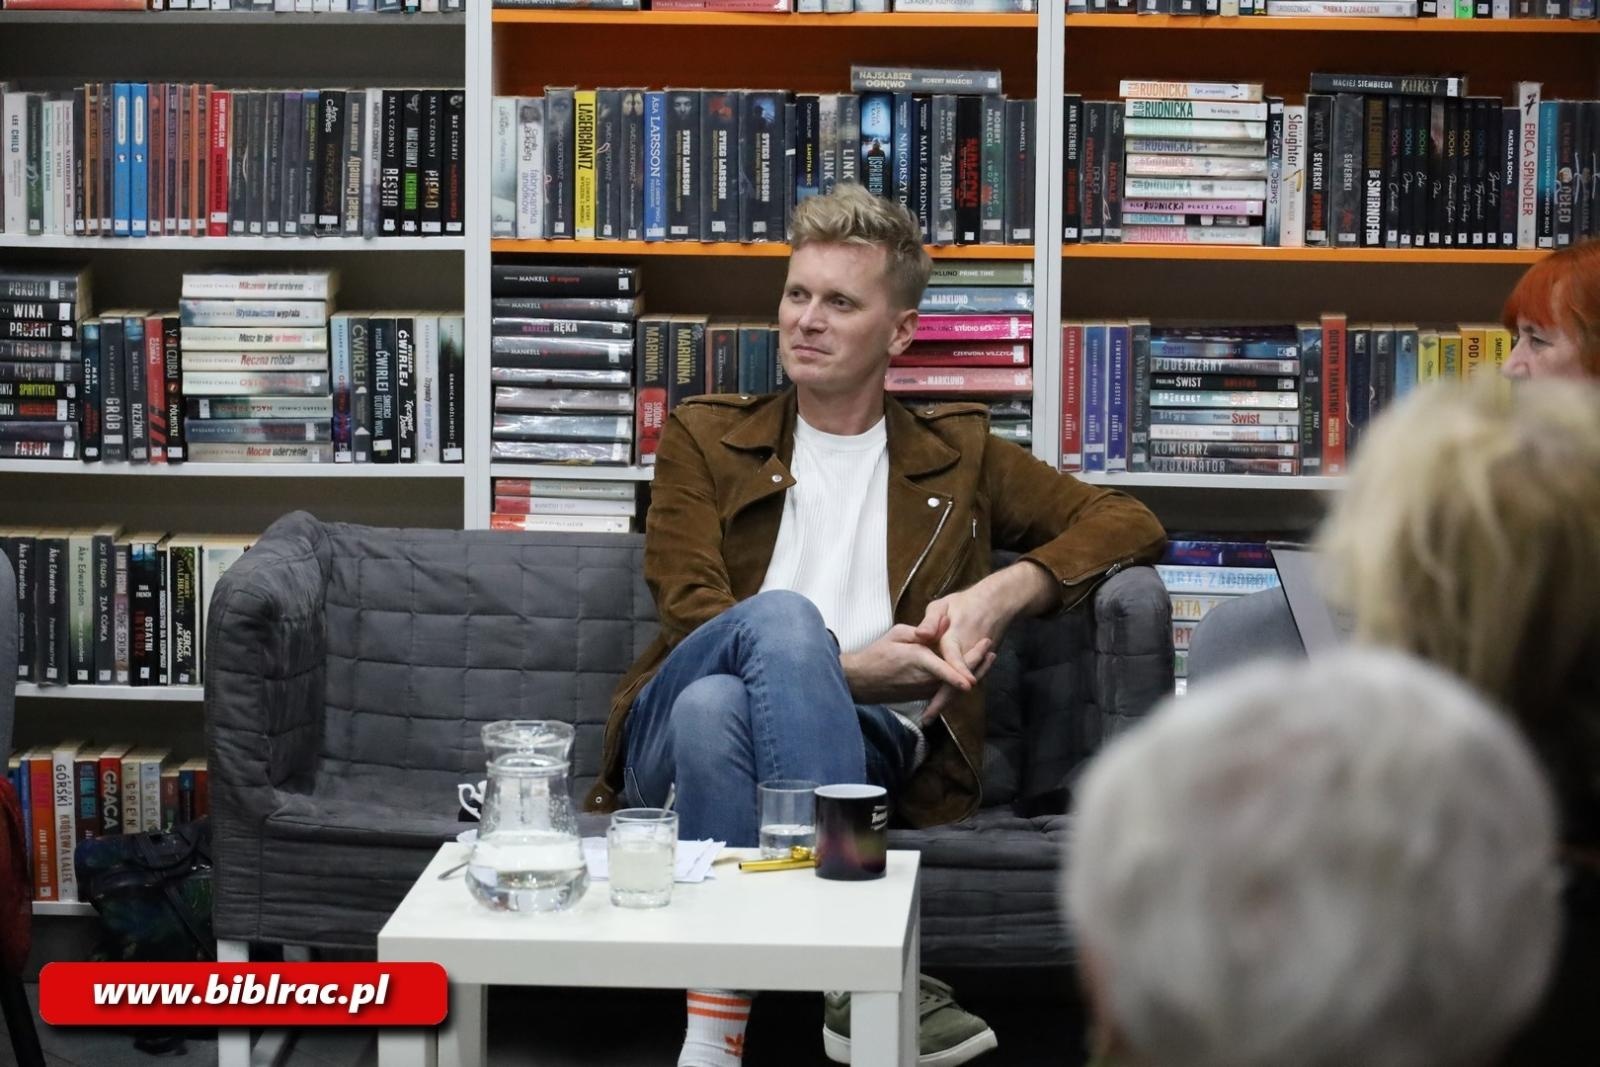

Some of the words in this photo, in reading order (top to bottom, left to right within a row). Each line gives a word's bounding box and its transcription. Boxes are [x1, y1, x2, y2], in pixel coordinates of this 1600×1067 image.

[859, 71, 913, 80] NAJSŁABSZE
[865, 79, 907, 90] OGNIWO
[921, 77, 944, 85] ROBERT
[1332, 79, 1356, 87] MACIEJ
[1357, 80, 1393, 89] SIEMBIEDA
[1400, 79, 1439, 93] KUKŁY
[1139, 83, 1188, 98] RUDNICKA
[324, 99, 333, 133] Cleeves
[330, 106, 338, 122] Ann
[651, 96, 660, 114] ÅSA
[1145, 100, 1193, 118] RUDNICKA
[11, 115, 20, 126] LEE
[406, 127, 418, 141] MAX
[1314, 111, 1322, 142] VINCENT
[10, 129, 19, 153] CHILD
[386, 118, 394, 158] CZORNYJ
[427, 118, 435, 158] CZORNYJ
[578, 103, 593, 170] LAGERCRANTZ
[650, 116, 660, 177] LARSSON
[682, 130, 690, 155] STIEG
[718, 130, 726, 157] STIEG
[761, 133, 769, 159] STIEG
[919, 135, 927, 165] MAŁE
[1067, 124, 1076, 160] ROZENBERG
[1145, 141, 1193, 152] RUDNICKA
[1270, 119, 1280, 159] TATRACH
[1285, 113, 1302, 167] Slaughter
[1524, 122, 1535, 157] ERICA
[406, 142, 417, 168] CZORNYJ
[823, 150, 834, 180] LINK
[842, 149, 854, 179] LINK
[896, 132, 907, 193] NAJGORSZY
[1271, 161, 1280, 170] W
[346, 156, 361, 195] Connelly
[682, 157, 690, 196] LARSSON
[718, 158, 726, 199] LARSSON
[761, 161, 769, 202] LARSSON
[939, 154, 952, 211] ŻAŁOBNICA
[1313, 152, 1322, 190] SEVERSKI
[1343, 153, 1352, 191] SEVERSKI
[382, 168, 398, 207] BESTIA
[424, 170, 438, 209] PIEKŁO
[521, 172, 529, 215] aniołków
[526, 169, 539, 224] fabrykantka
[919, 166, 927, 221] ZBRODNIE
[1523, 160, 1534, 216] SPINDLER
[1143, 200, 1184, 211] RUDNICKA
[1558, 186, 1571, 223] OBŁĘD
[1140, 227, 1188, 242] RUDNICKA
[8, 282, 45, 297] POKUTA
[238, 281, 266, 290] Milczenie
[267, 282, 279, 291] jest
[279, 282, 304, 291] srebrem
[931, 294, 968, 305] MARKLUND
[13, 304, 44, 318] WINA
[276, 309, 300, 319] wypłata
[9, 322, 53, 338] PACJENT
[238, 333, 256, 343] Masz
[256, 333, 263, 342] to
[263, 334, 273, 344] jak
[553, 322, 578, 335] RĘKA
[954, 324, 979, 332] STUDIO
[11, 344, 53, 358] TRAUMA
[240, 354, 269, 366] Ręczna
[270, 354, 295, 365] robota
[352, 324, 368, 385] ĆWIRLEJ
[398, 329, 409, 387] ĆWIRLEJ
[511, 348, 540, 356] MANKELL
[645, 326, 658, 383] MARININA
[677, 328, 690, 385] MARININA
[1328, 329, 1339, 365] QUENTIN
[1468, 337, 1479, 358] POD
[1494, 337, 1503, 361] ŚMIERĆ
[166, 349, 177, 379] CZUBAJ
[375, 350, 391, 392] ĆWIRLEJ
[1155, 360, 1223, 372] PODEJRZANY
[927, 375, 965, 386] MARKLUND
[1175, 376, 1202, 388] ŚWIST
[1327, 367, 1338, 413] TARANTINO
[105, 397, 122, 430] GRÓB
[169, 404, 178, 437] PÓŁMISTRZ
[374, 395, 382, 418] ULOTNY
[383, 395, 392, 419] ŚMIERCI
[404, 399, 413, 432] Tęczowa
[643, 402, 652, 428] OFIARA
[652, 401, 662, 429] SIÓDMA
[1232, 411, 1261, 425] Świst
[1303, 396, 1313, 445] ZAŚNIESZ
[131, 403, 144, 439] RZEŹNIK
[374, 420, 382, 437] WOAL
[399, 414, 407, 439] Dolina
[15, 441, 51, 456] FATUM
[246, 446, 272, 456] Mocne
[272, 446, 308, 457] uderzenie
[1154, 442, 1209, 456] KOMISARZ
[1154, 459, 1225, 473] PROKURATOR
[19, 543, 29, 558] Åke
[49, 547, 59, 562] Åke
[77, 546, 89, 561] Åke
[19, 559, 27, 599] Edwardson
[49, 564, 57, 604] Edwardson
[77, 563, 86, 606] Edwardson
[176, 560, 184, 614] GALBRAITH
[99, 596, 107, 612] ZŁA
[99, 614, 108, 642] CÓRKA
[134, 611, 144, 657] INTRUZ
[144, 616, 152, 651] OSTATNI
[159, 629, 166, 638] NA
[47, 640, 55, 667] martwy
[183, 629, 191, 657] SERCE
[55, 764, 69, 807] GÓRSKI
[102, 770, 117, 829] GRACA
[59, 814, 71, 855] KRÓLOWA
[61, 856, 71, 884] LALEK
